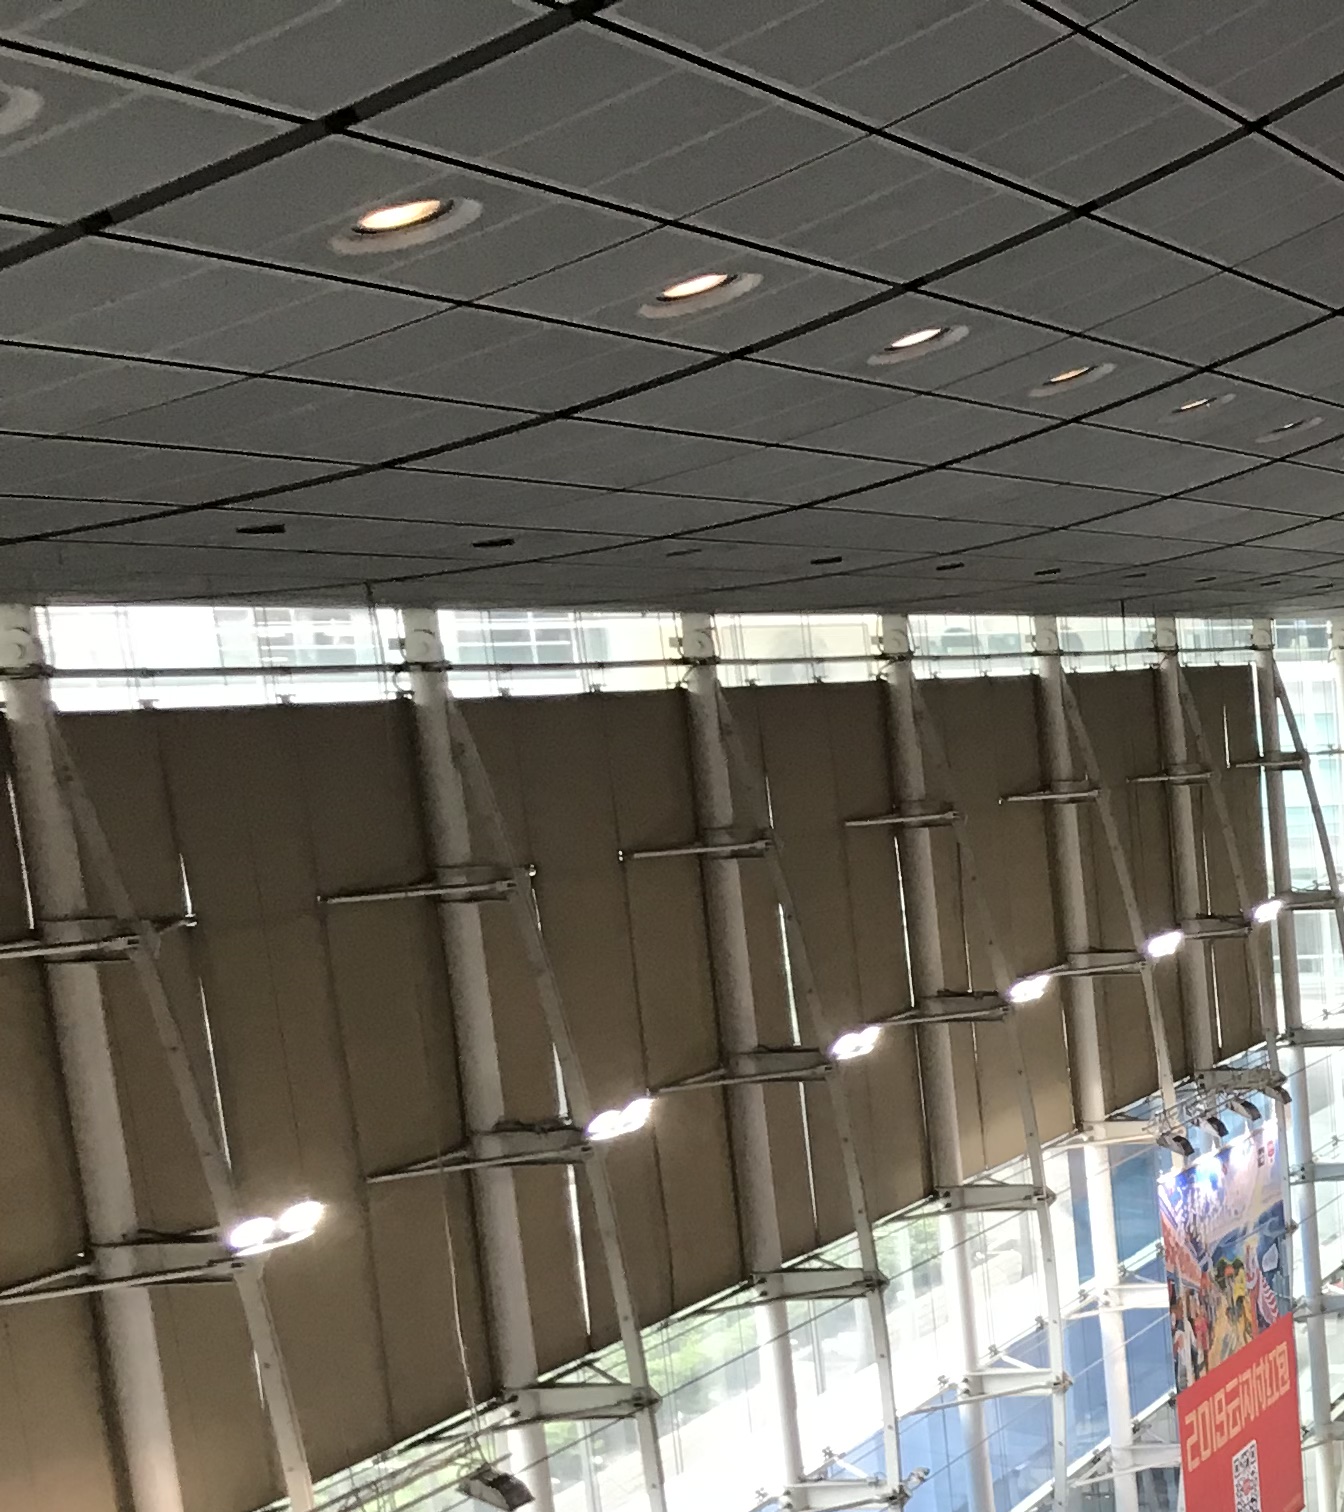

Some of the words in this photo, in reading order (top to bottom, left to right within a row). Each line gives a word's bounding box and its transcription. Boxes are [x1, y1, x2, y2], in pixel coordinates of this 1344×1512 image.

[1185, 1341, 1290, 1473] 2019云闪付红包
